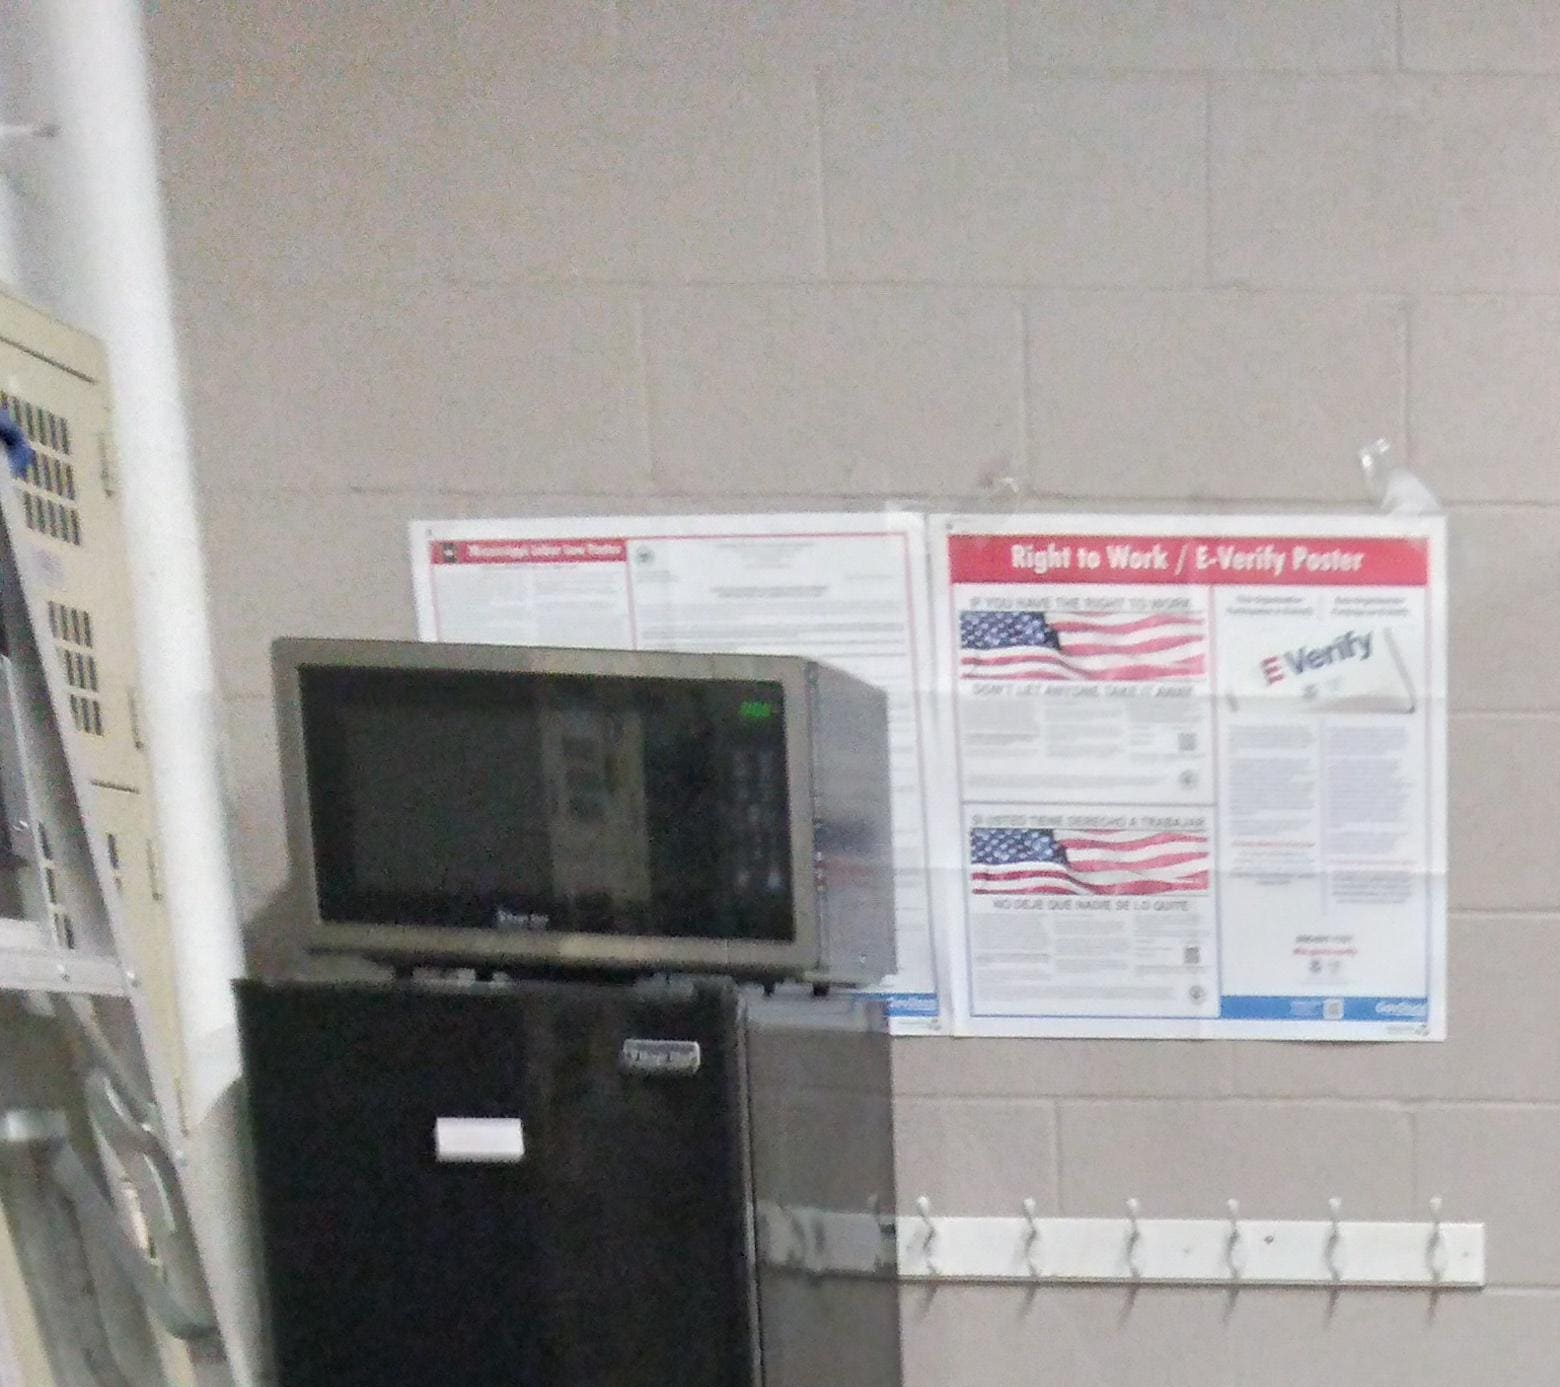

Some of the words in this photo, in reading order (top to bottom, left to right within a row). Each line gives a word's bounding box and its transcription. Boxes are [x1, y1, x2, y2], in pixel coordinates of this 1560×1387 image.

[1010, 543, 1072, 574] Right
[1076, 544, 1101, 569] to
[1105, 543, 1169, 570] Work
[1174, 544, 1188, 576] /
[1196, 545, 1286, 577] E-Verify
[1291, 545, 1364, 572] Poster
